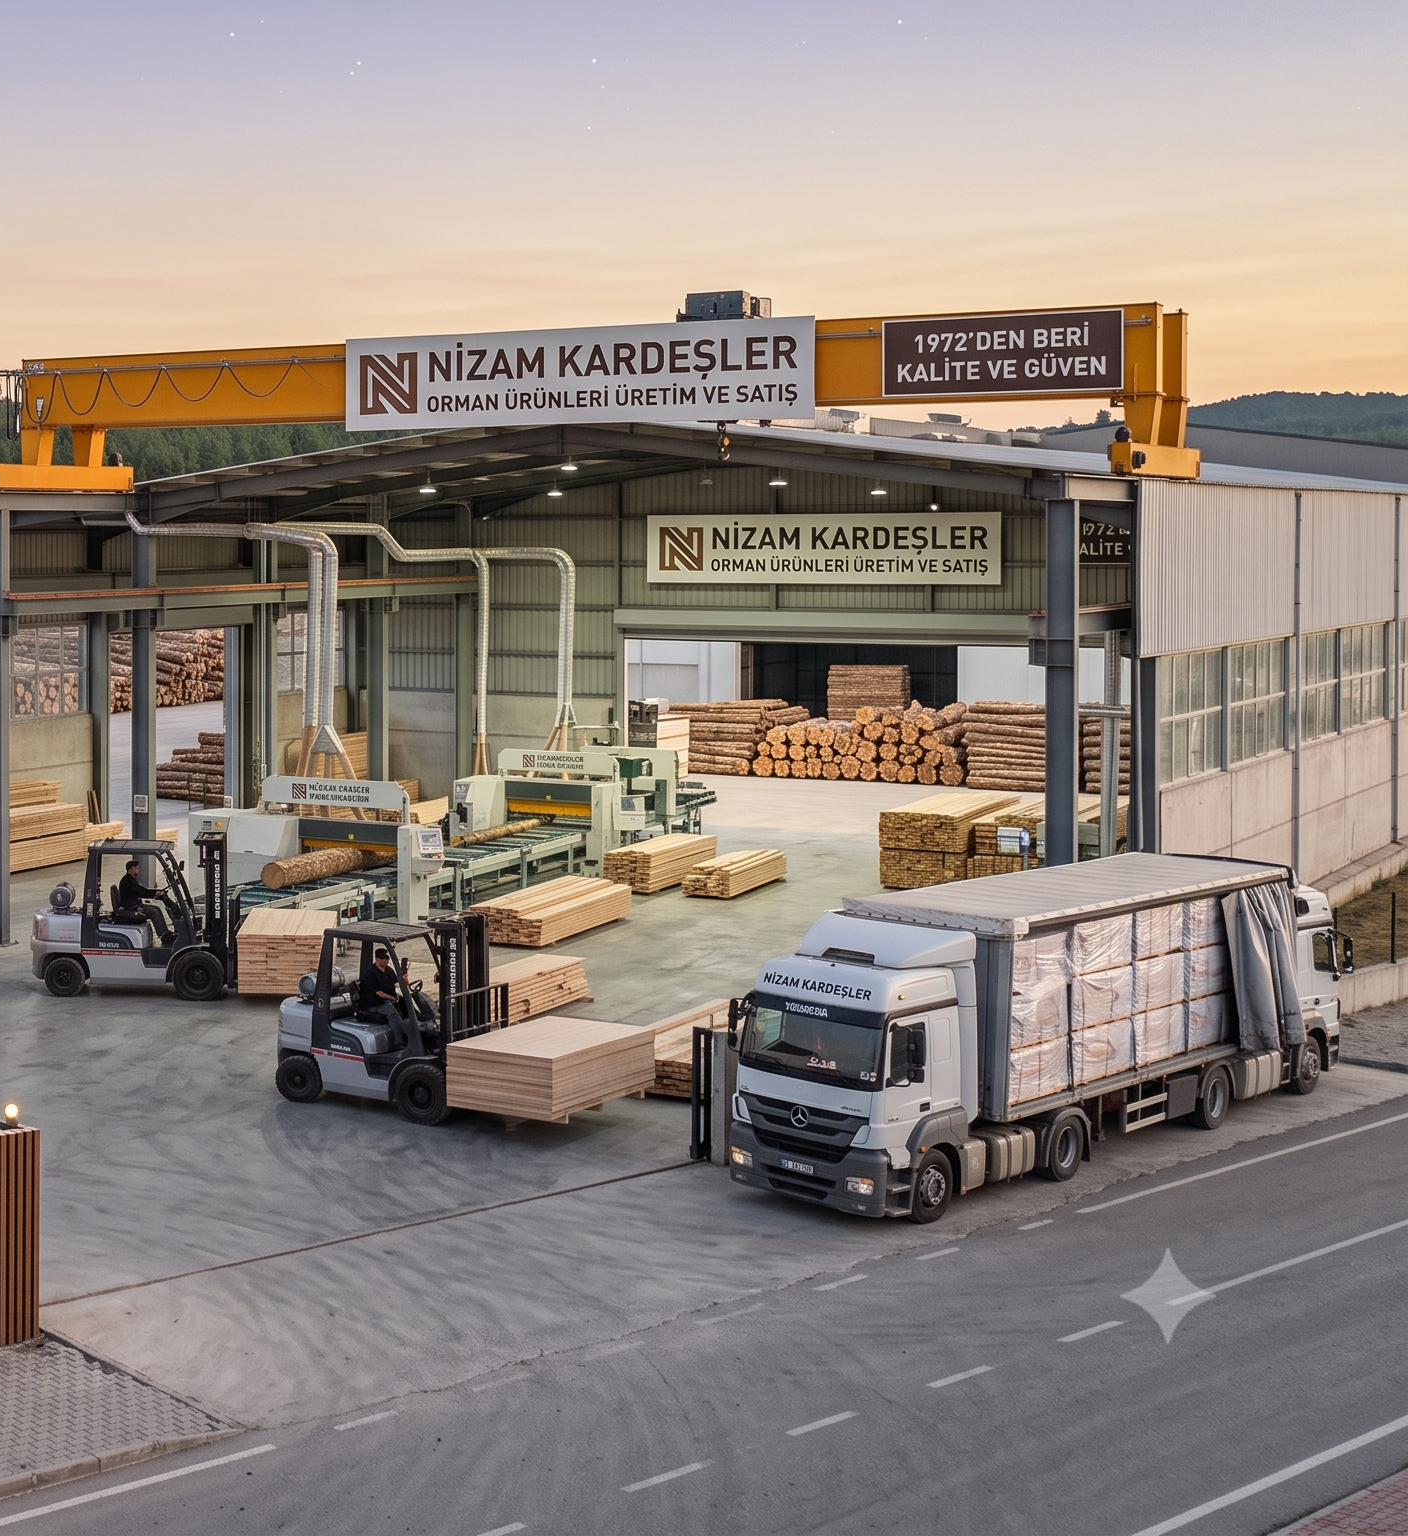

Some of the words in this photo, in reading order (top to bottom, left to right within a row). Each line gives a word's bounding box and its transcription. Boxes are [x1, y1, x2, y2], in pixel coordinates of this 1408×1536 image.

[914, 329, 1025, 354] 1972'DEN
[1033, 321, 1089, 348] BERİ
[428, 342, 545, 383] NİZAM
[558, 335, 798, 380] KARDEŞLER
[897, 357, 981, 383] KALİTE
[987, 359, 1017, 379] VE
[1024, 353, 1106, 378] GÜVEN
[427, 393, 499, 414] ORMAN
[505, 385, 609, 410] ÜRÜNLERİ
[615, 382, 696, 407] ÜRETİM
[702, 385, 730, 404] VE
[736, 383, 798, 407] SATIŞ
[712, 521, 800, 550] NİZAM
[811, 525, 989, 556] KARDEŞLER
[1079, 539, 1123, 555] ALİTE
[711, 558, 766, 573] ORMAN
[770, 555, 849, 573] ÜRÜNLERİ
[854, 555, 914, 573] ÜRETİM
[918, 558, 938, 573] VE
[942, 558, 989, 576] SATIŞ
[763, 972, 800, 988] NİZAM
[801, 979, 872, 1001] KARDEŞLER
